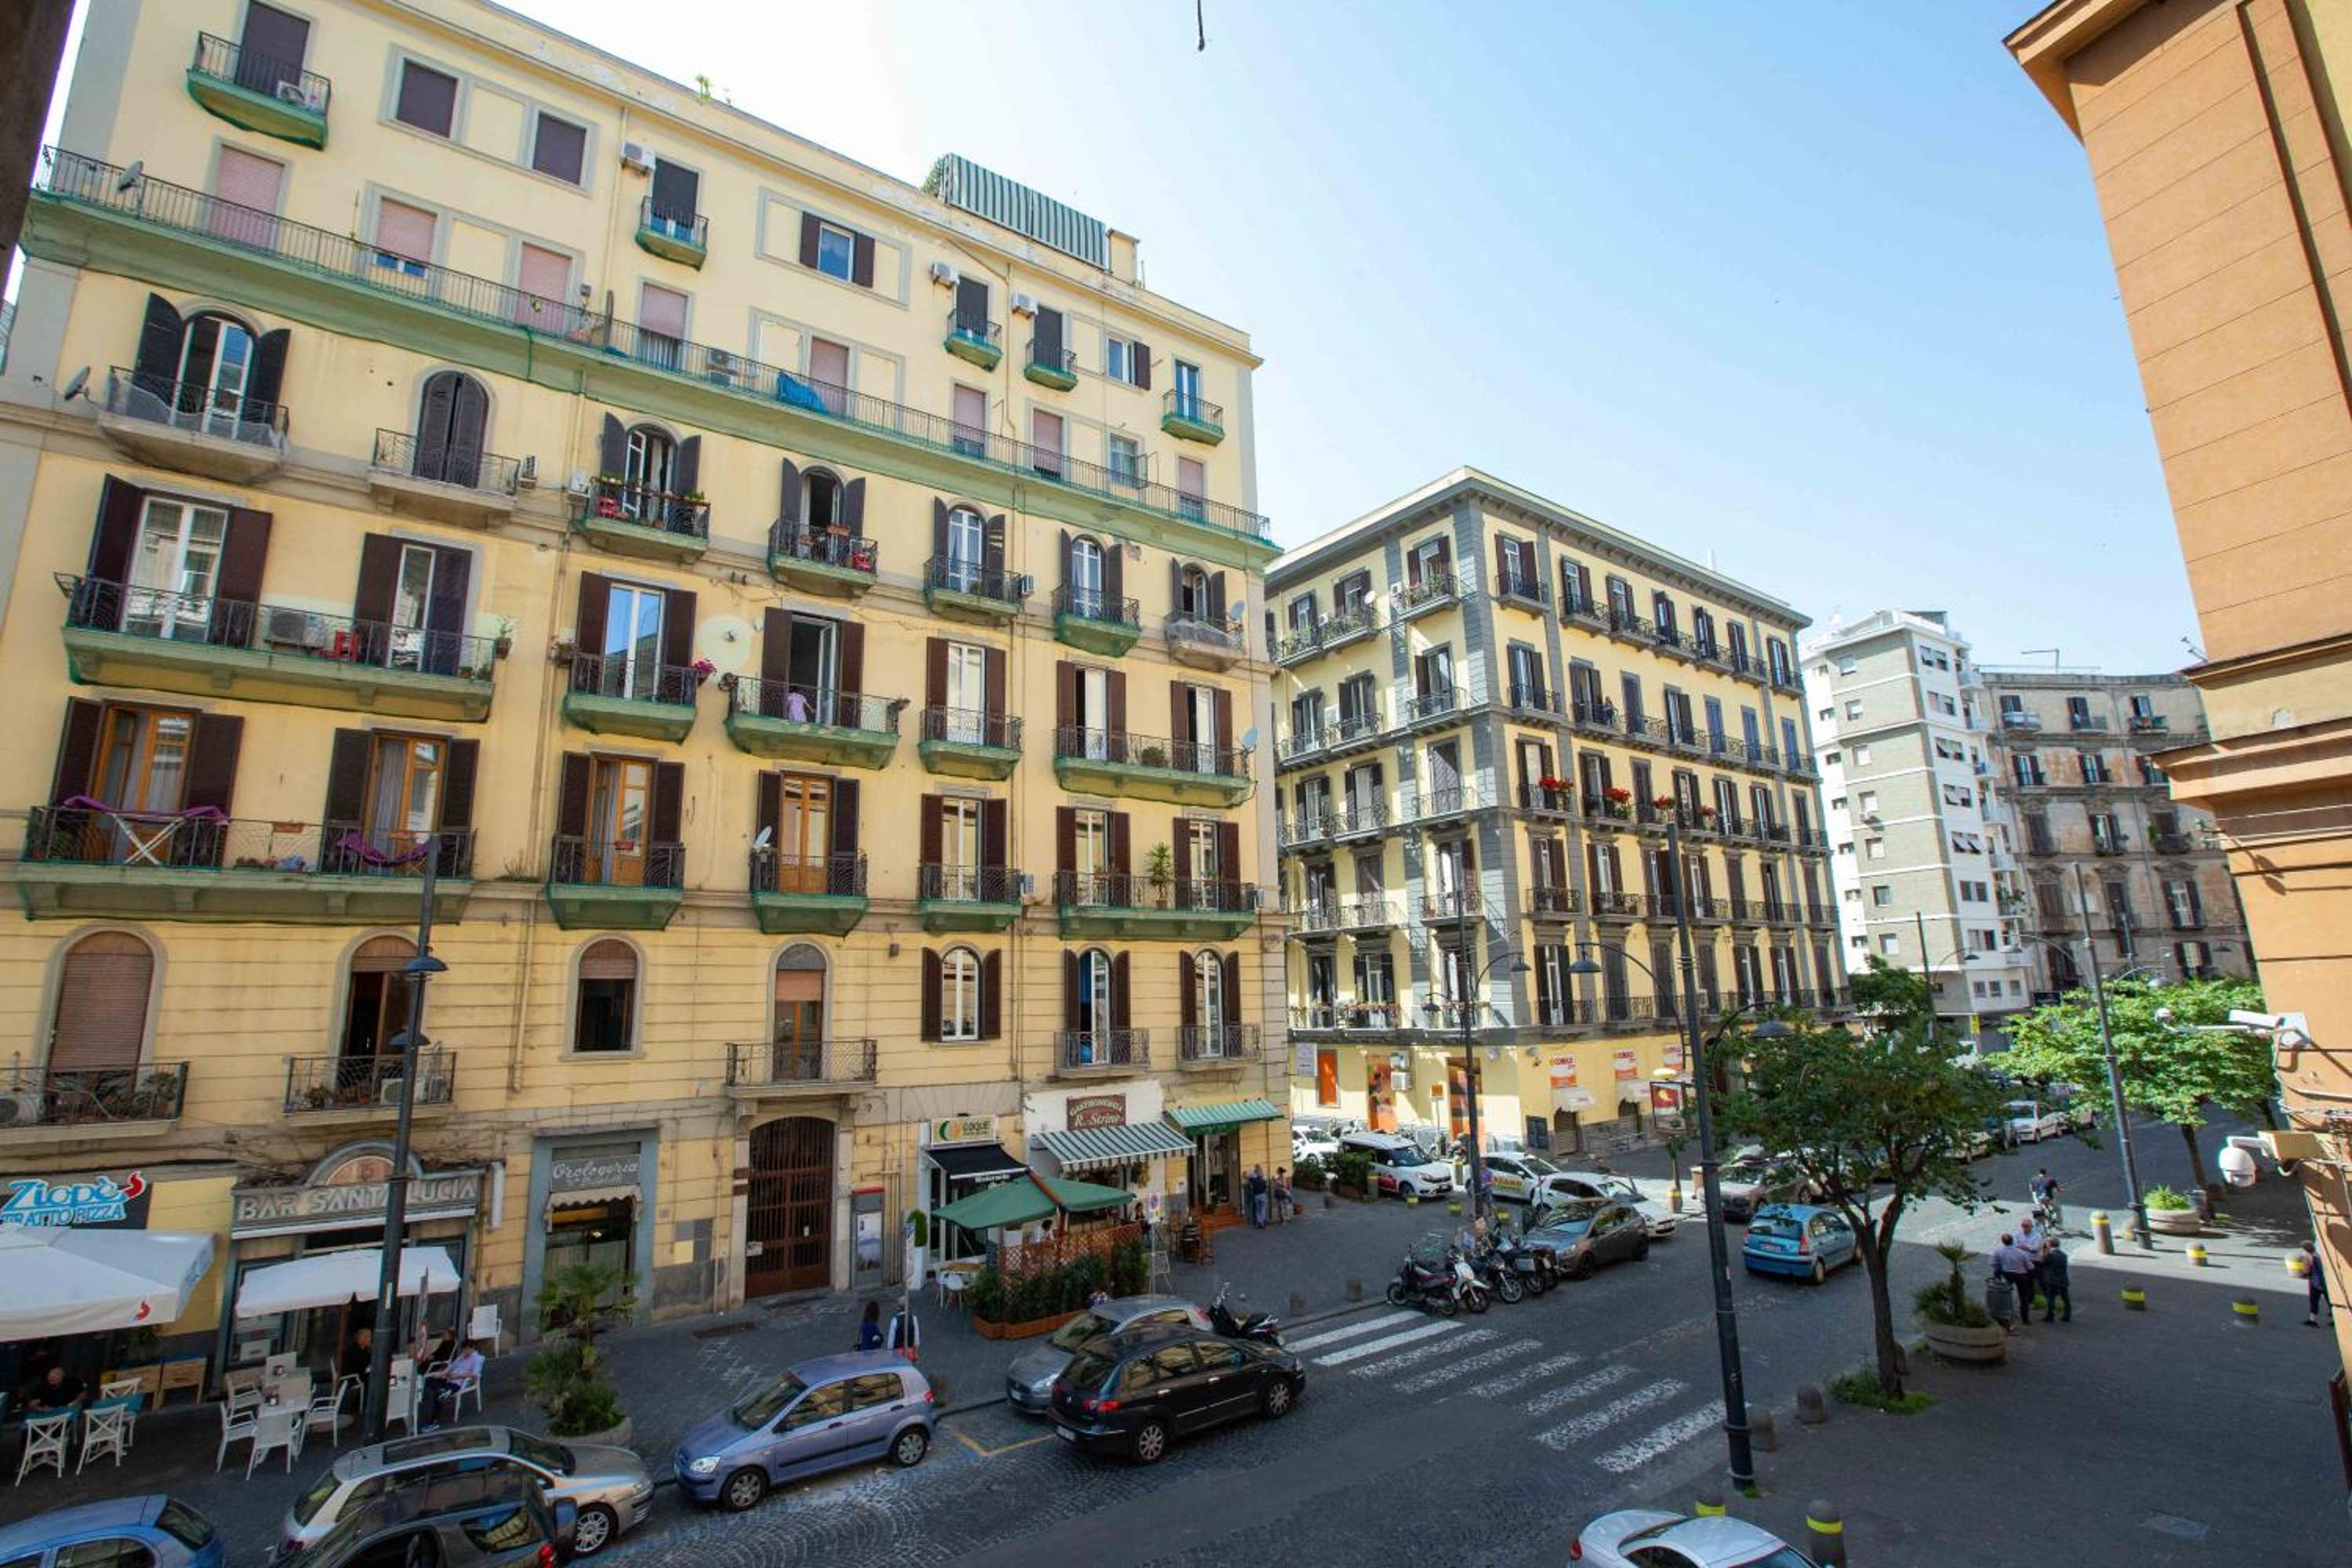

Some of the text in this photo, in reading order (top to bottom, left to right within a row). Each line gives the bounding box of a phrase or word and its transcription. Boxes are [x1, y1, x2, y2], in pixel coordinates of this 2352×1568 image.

[552, 1160, 638, 1179] Orologeria
[238, 1196, 296, 1220] BAR
[405, 1178, 477, 1204] LUCIA
[75, 1203, 125, 1222] PIZZA
